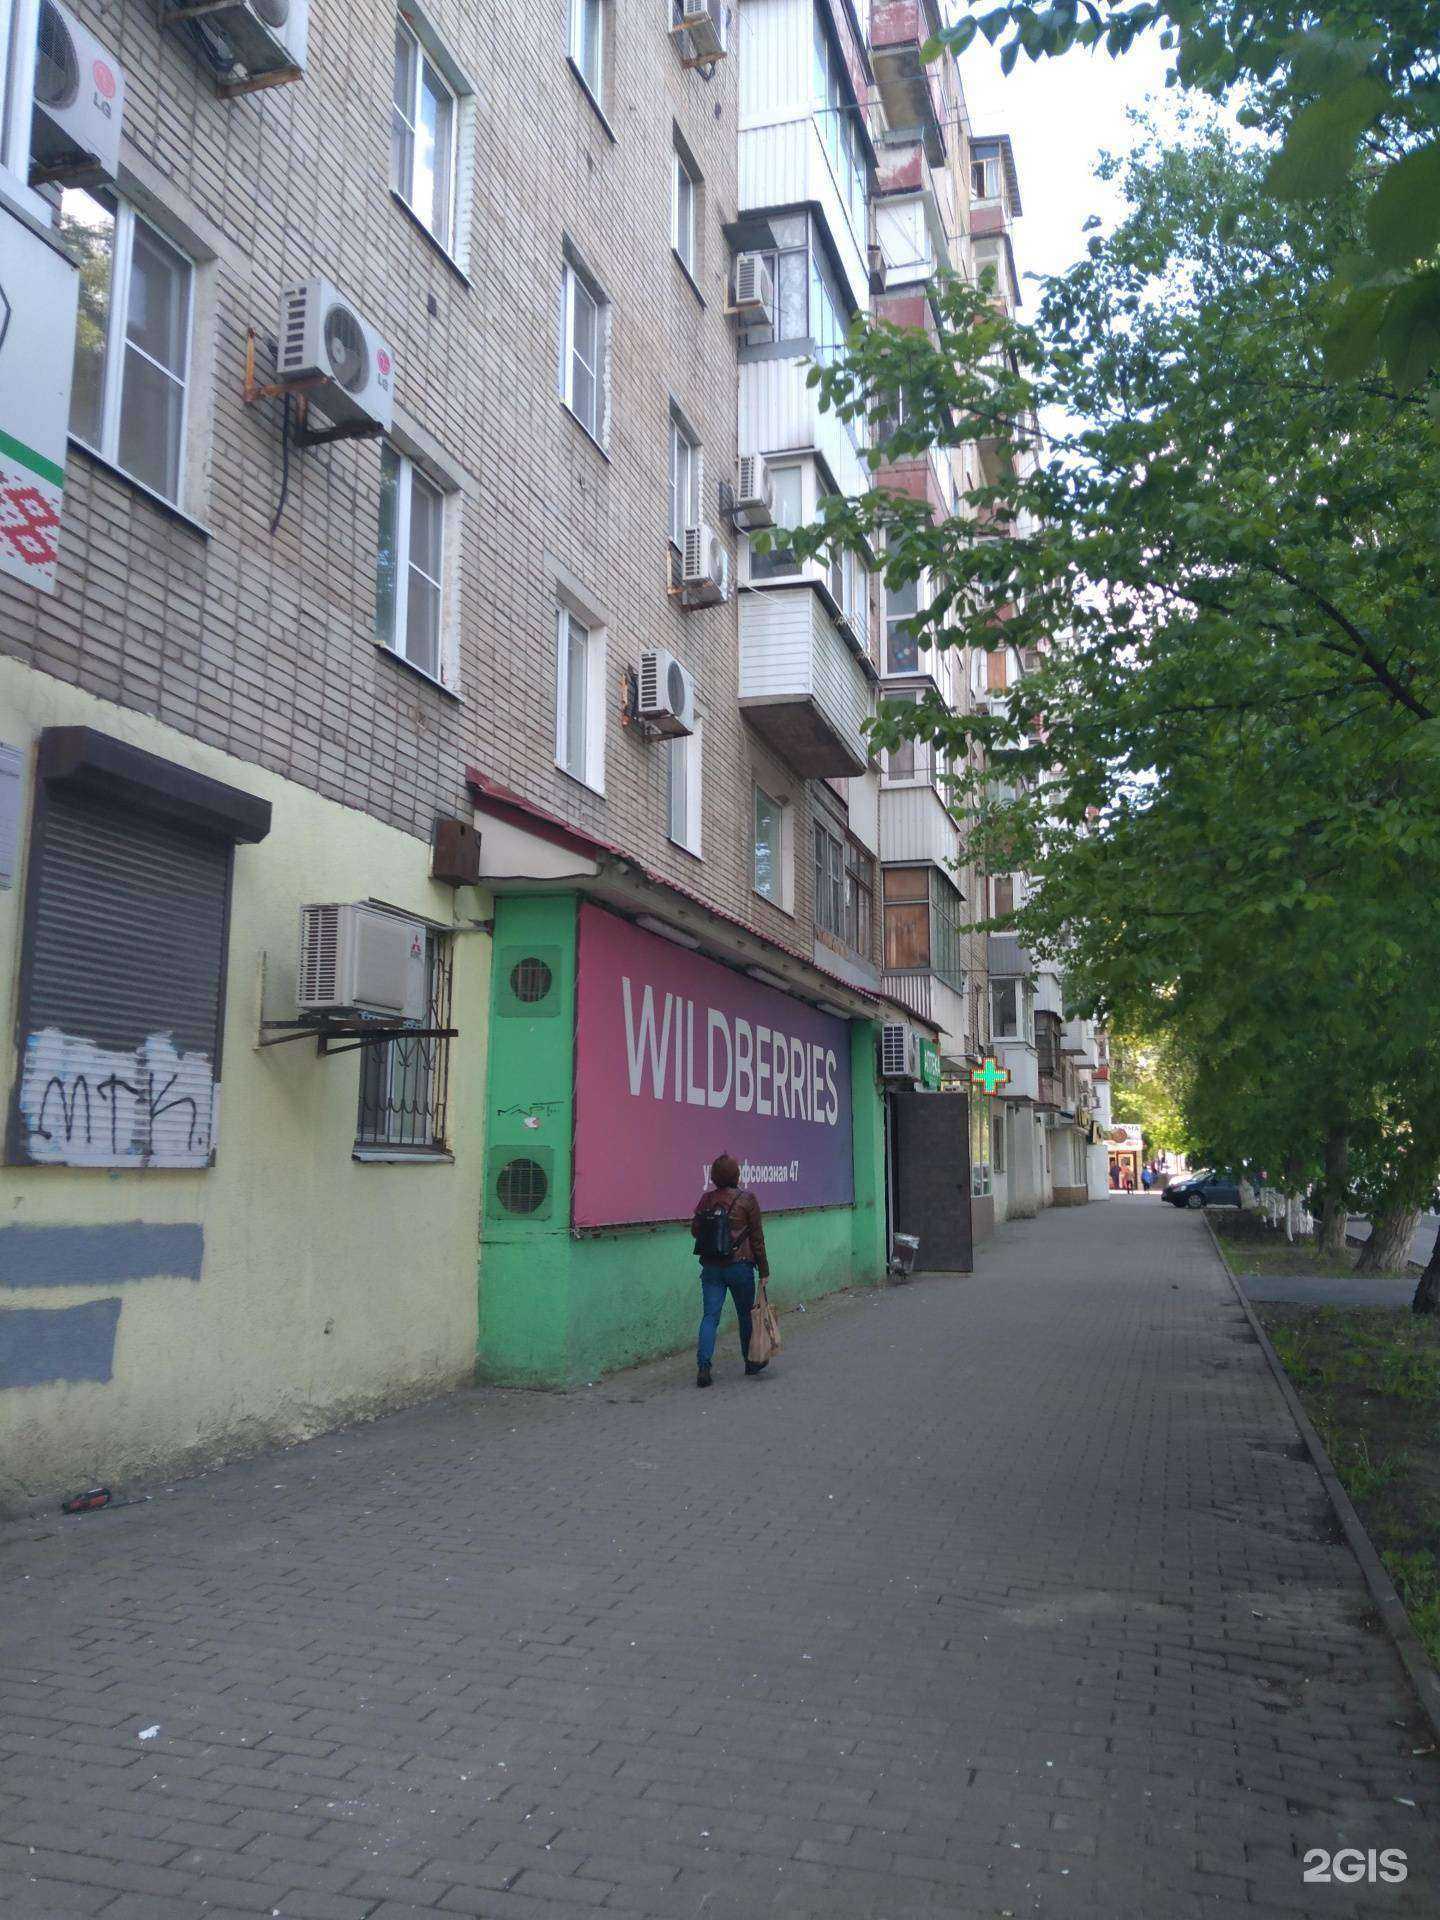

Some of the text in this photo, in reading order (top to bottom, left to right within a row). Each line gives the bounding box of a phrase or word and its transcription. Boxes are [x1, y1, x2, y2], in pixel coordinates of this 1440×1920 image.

[93, 91, 112, 120] LG
[622, 976, 838, 1126] WILDBERRIES
[738, 1159, 788, 1189] фсоюзная
[789, 1160, 799, 1182] 47
